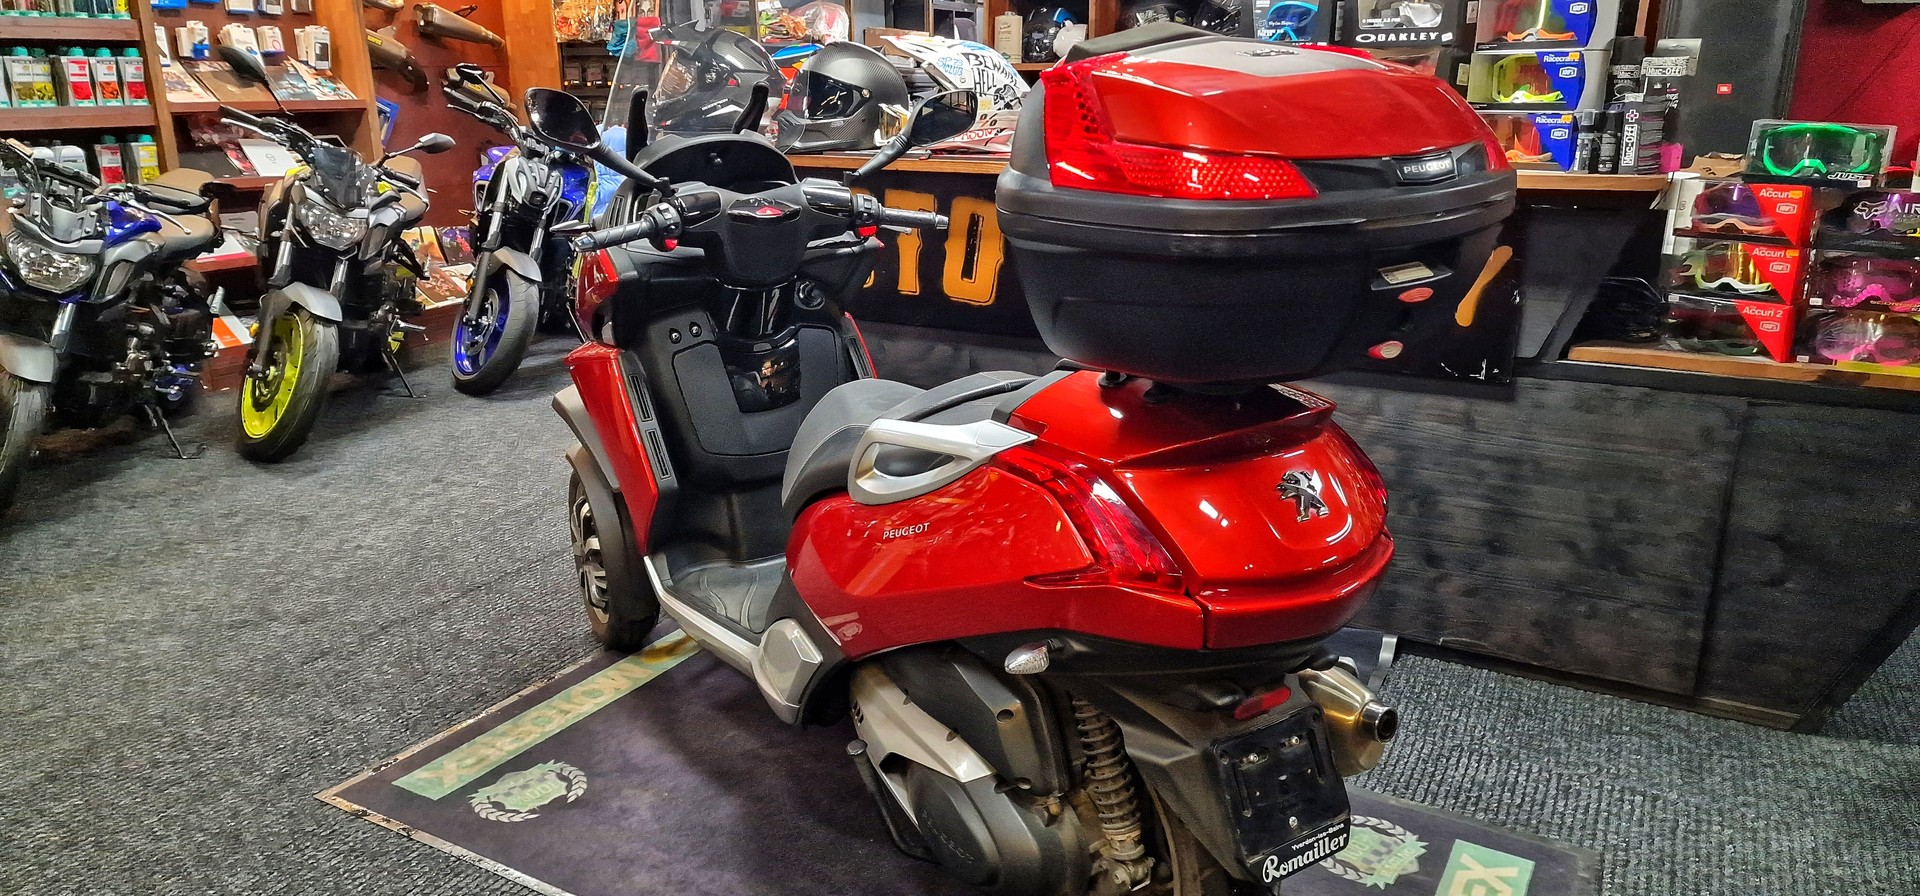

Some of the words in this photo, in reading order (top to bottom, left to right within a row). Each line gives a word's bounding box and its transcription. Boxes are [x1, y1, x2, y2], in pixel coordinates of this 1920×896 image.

[1377, 31, 1439, 42] OAKLEY
[1648, 67, 1680, 75] Muc-Off
[970, 68, 997, 98] HELL
[1622, 125, 1636, 166] Muc-Off
[1403, 158, 1453, 173] PEUGEOT
[1752, 247, 1785, 258] Accuri
[1743, 306, 1775, 317] Accuri
[1776, 310, 1783, 318] 2
[882, 521, 931, 540] PEUGEOT
[1261, 832, 1348, 884] Romailler
